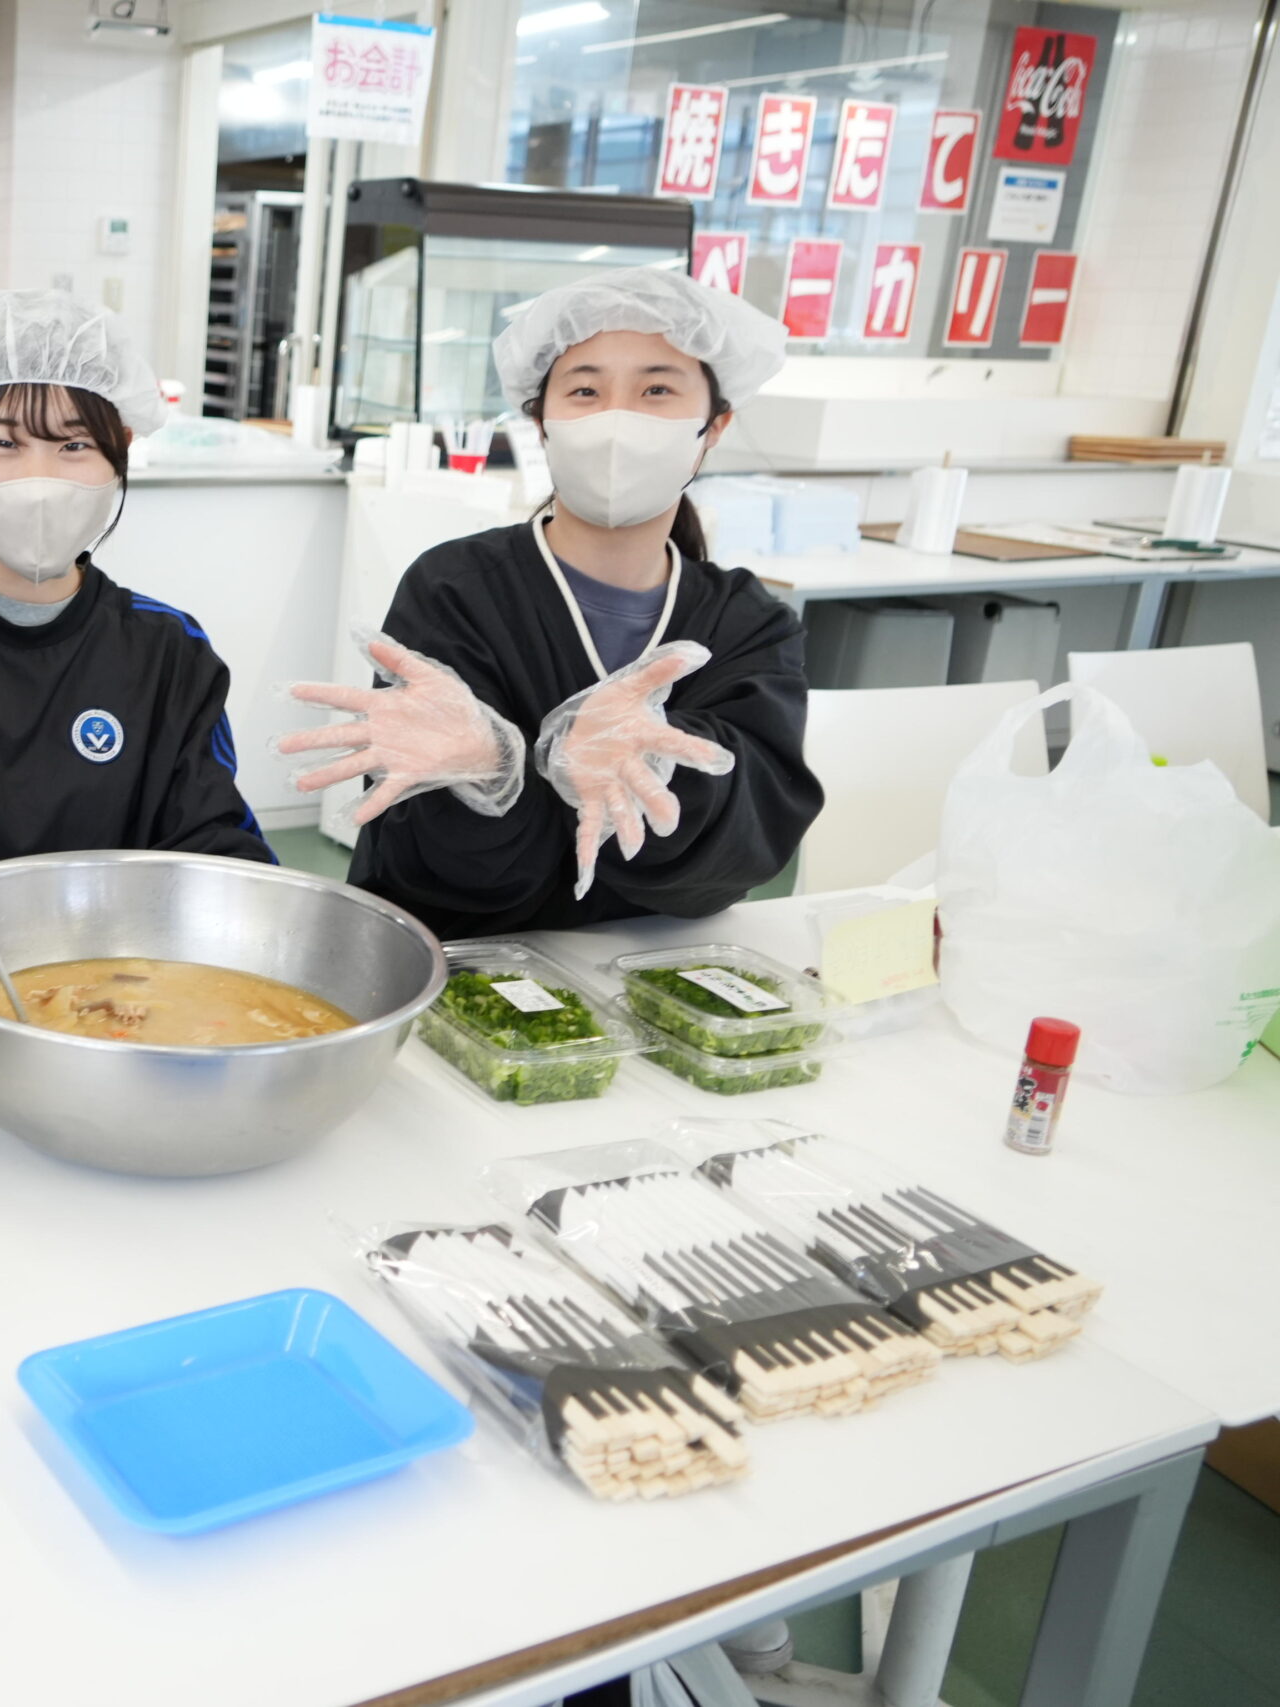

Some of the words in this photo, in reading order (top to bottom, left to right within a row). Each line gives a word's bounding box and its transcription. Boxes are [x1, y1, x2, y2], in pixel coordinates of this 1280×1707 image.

[323, 38, 421, 98] お会計
[664, 89, 976, 203] 焼きたて
[697, 238, 1070, 337] ベーカリー
